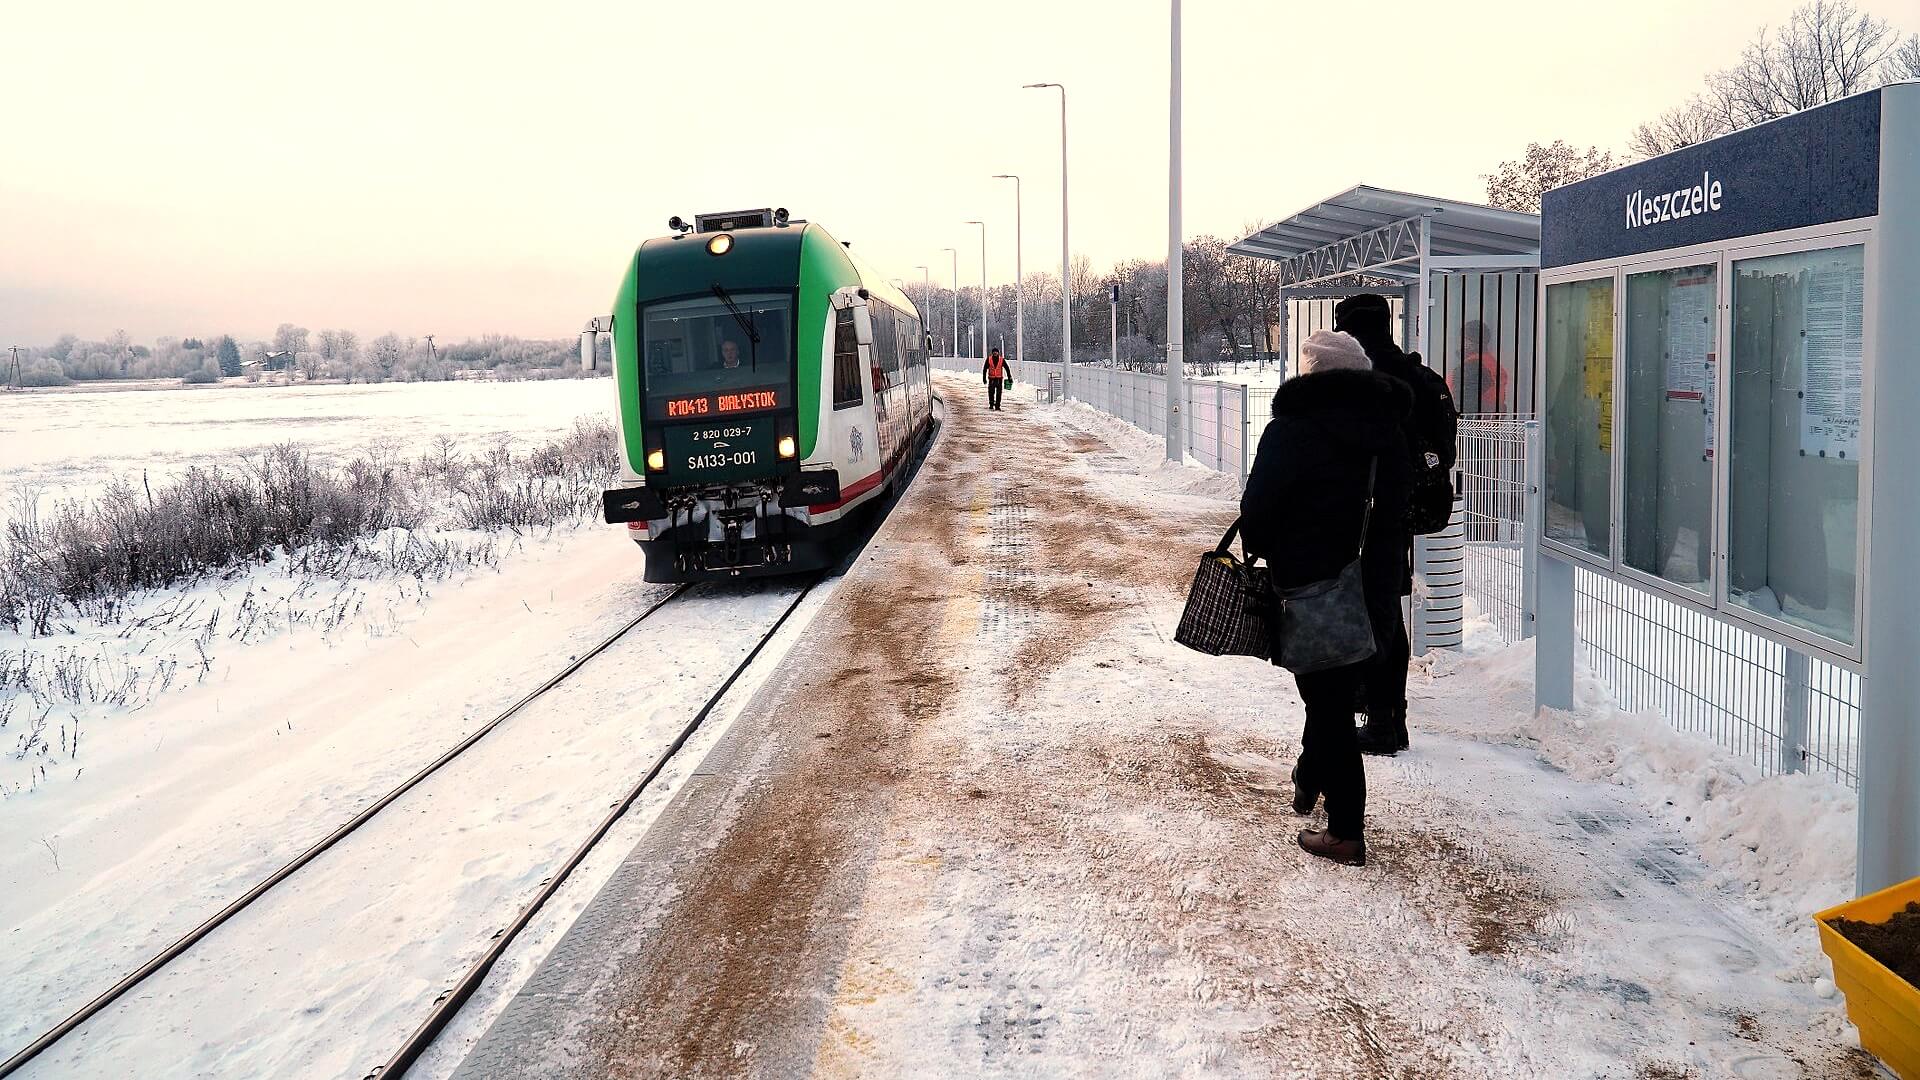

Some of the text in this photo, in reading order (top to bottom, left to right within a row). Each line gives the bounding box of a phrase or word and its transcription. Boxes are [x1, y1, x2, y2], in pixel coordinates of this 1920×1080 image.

[1626, 171, 1722, 229] Kleszczele
[668, 391, 776, 416] R10413 BIAŁYSTOK
[693, 426, 752, 441] 2 820 029-7
[688, 450, 756, 469] SA133-001
